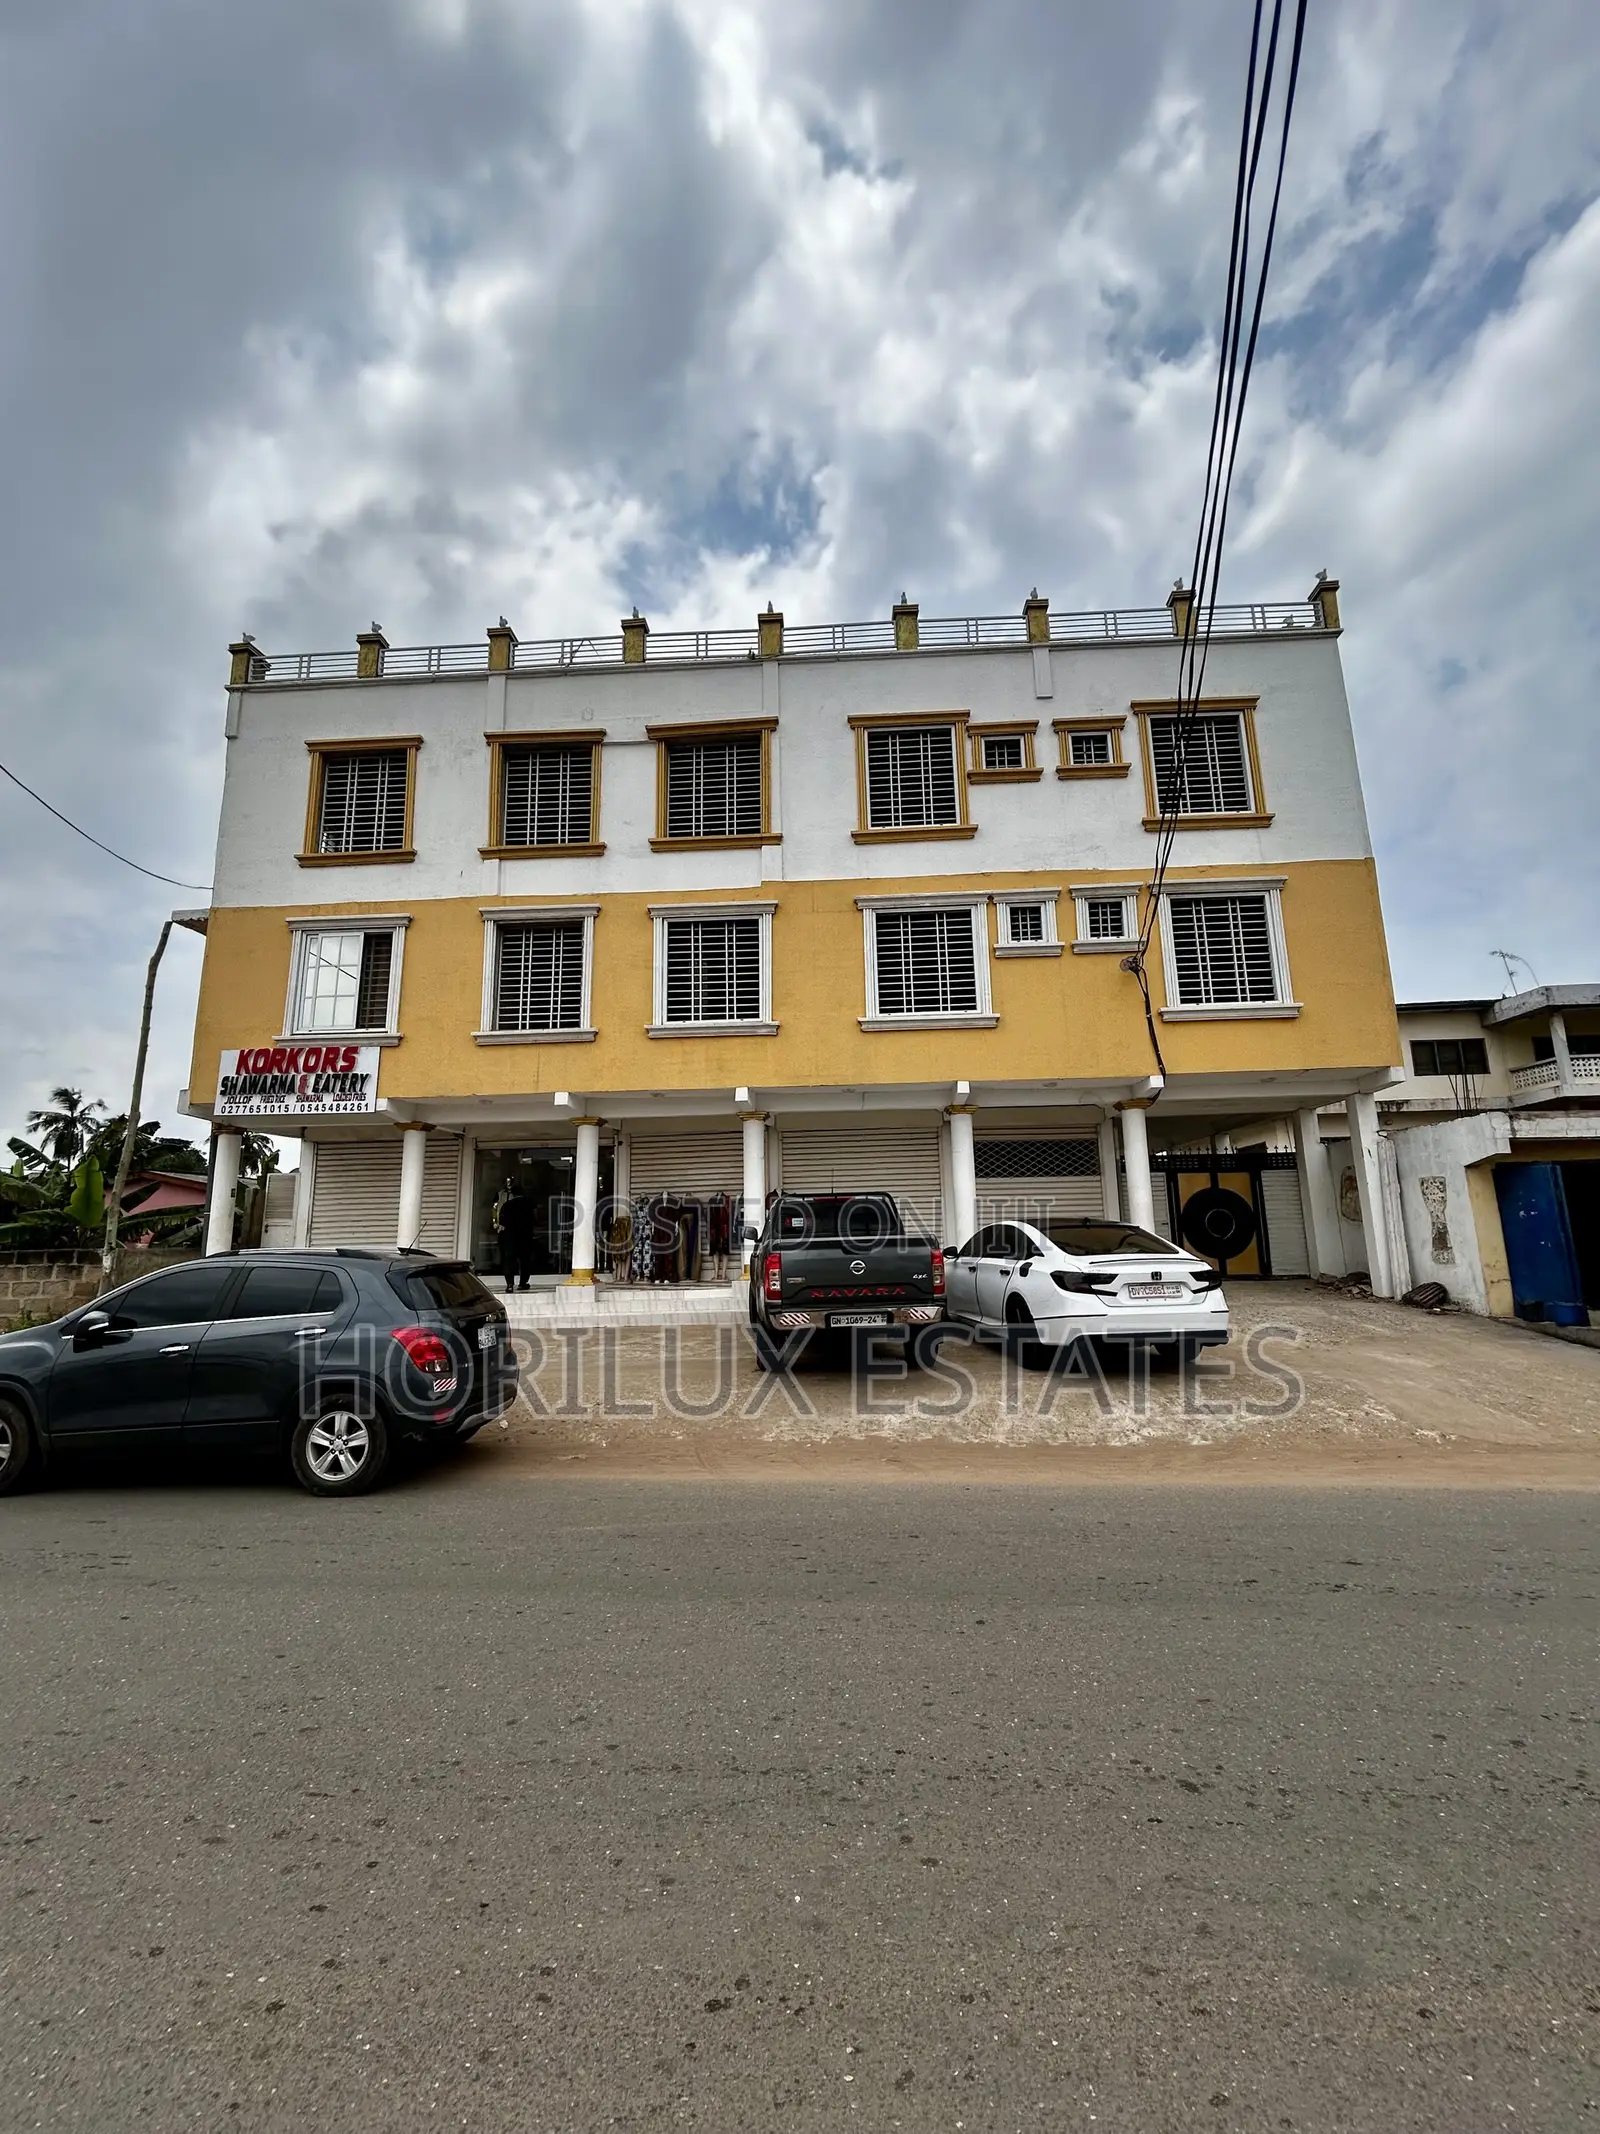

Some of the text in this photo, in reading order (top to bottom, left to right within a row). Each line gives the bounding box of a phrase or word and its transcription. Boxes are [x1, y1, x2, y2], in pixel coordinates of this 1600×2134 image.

[235, 1046, 359, 1075] KORKORS
[220, 1073, 371, 1096] SHAWARMA & EATERY
[224, 1095, 253, 1105] JOLLOF
[296, 1093, 323, 1103] SHAWARMA
[810, 1286, 906, 1298] NAVARA
